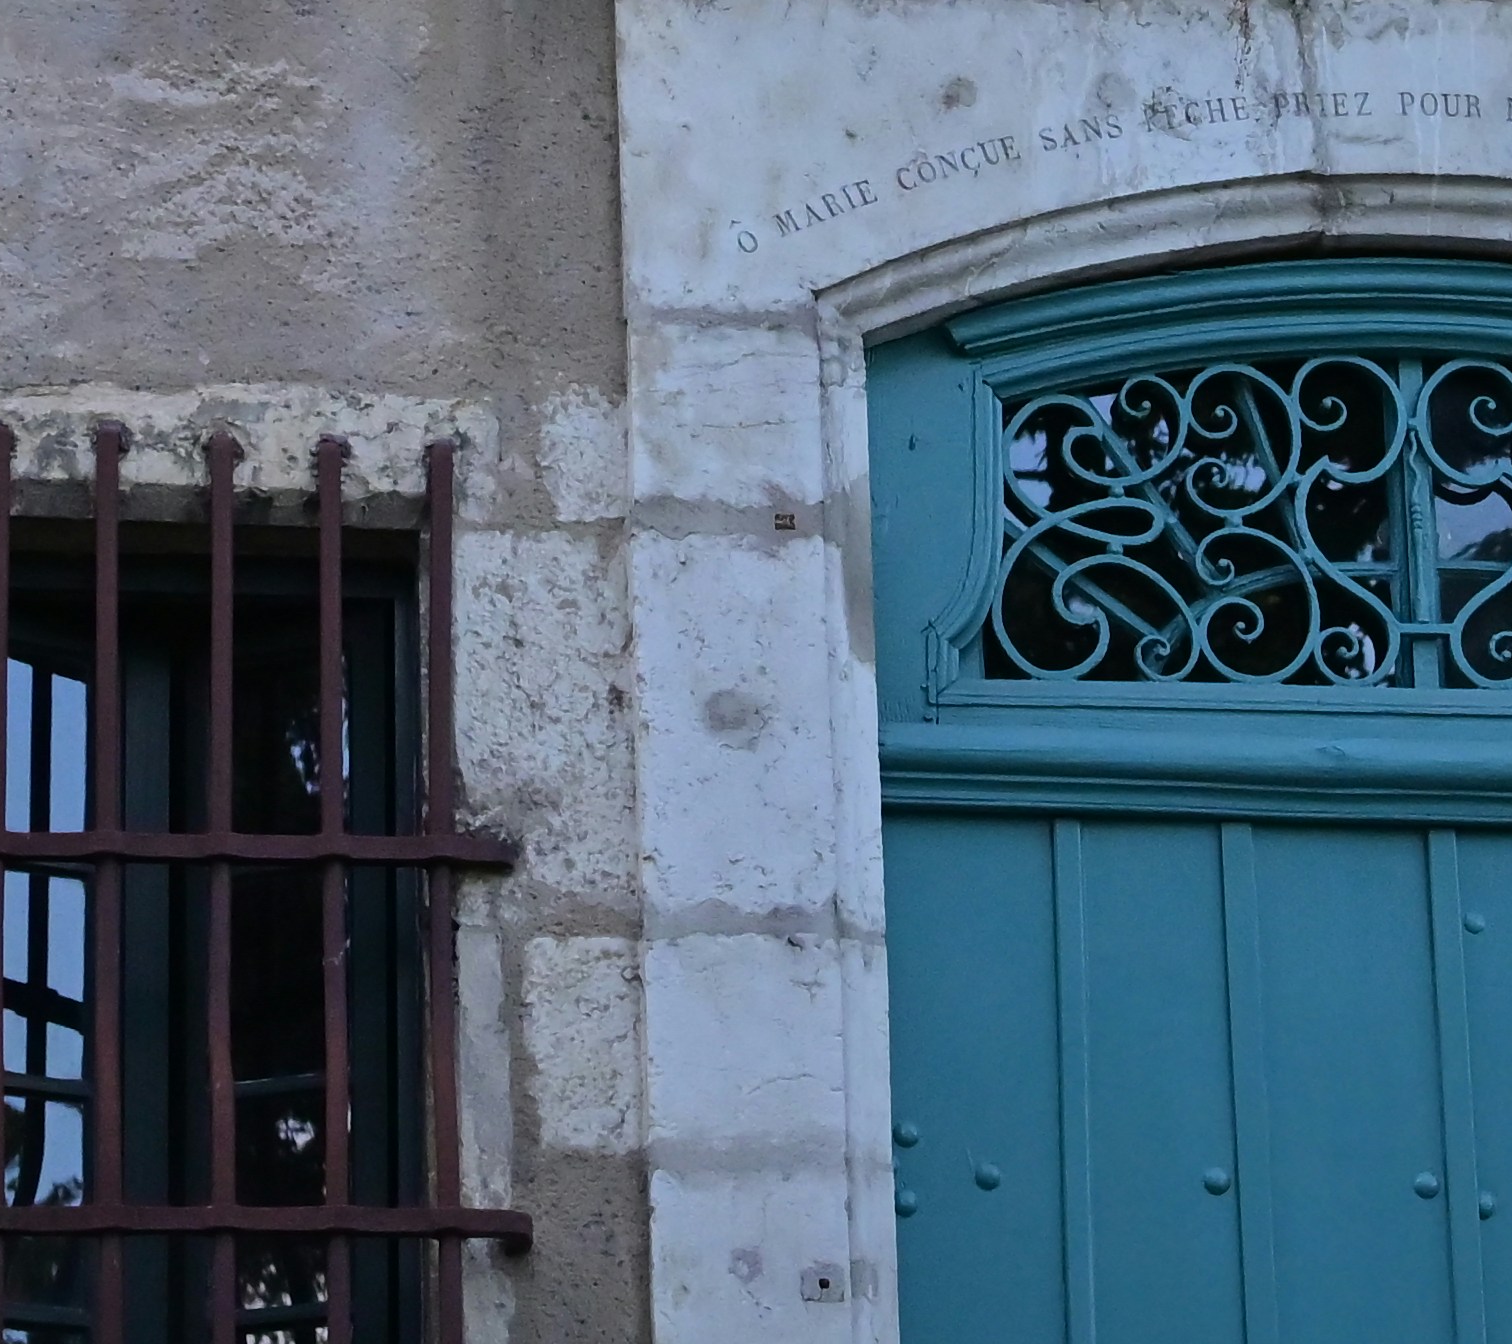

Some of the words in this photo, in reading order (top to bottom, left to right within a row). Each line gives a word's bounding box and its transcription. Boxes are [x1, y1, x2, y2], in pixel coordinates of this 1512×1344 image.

[772, 179, 879, 238] MARIE
[1038, 113, 1124, 152] SANS
[1272, 91, 1373, 120] PRIEZ
[1398, 91, 1482, 119] POUR
